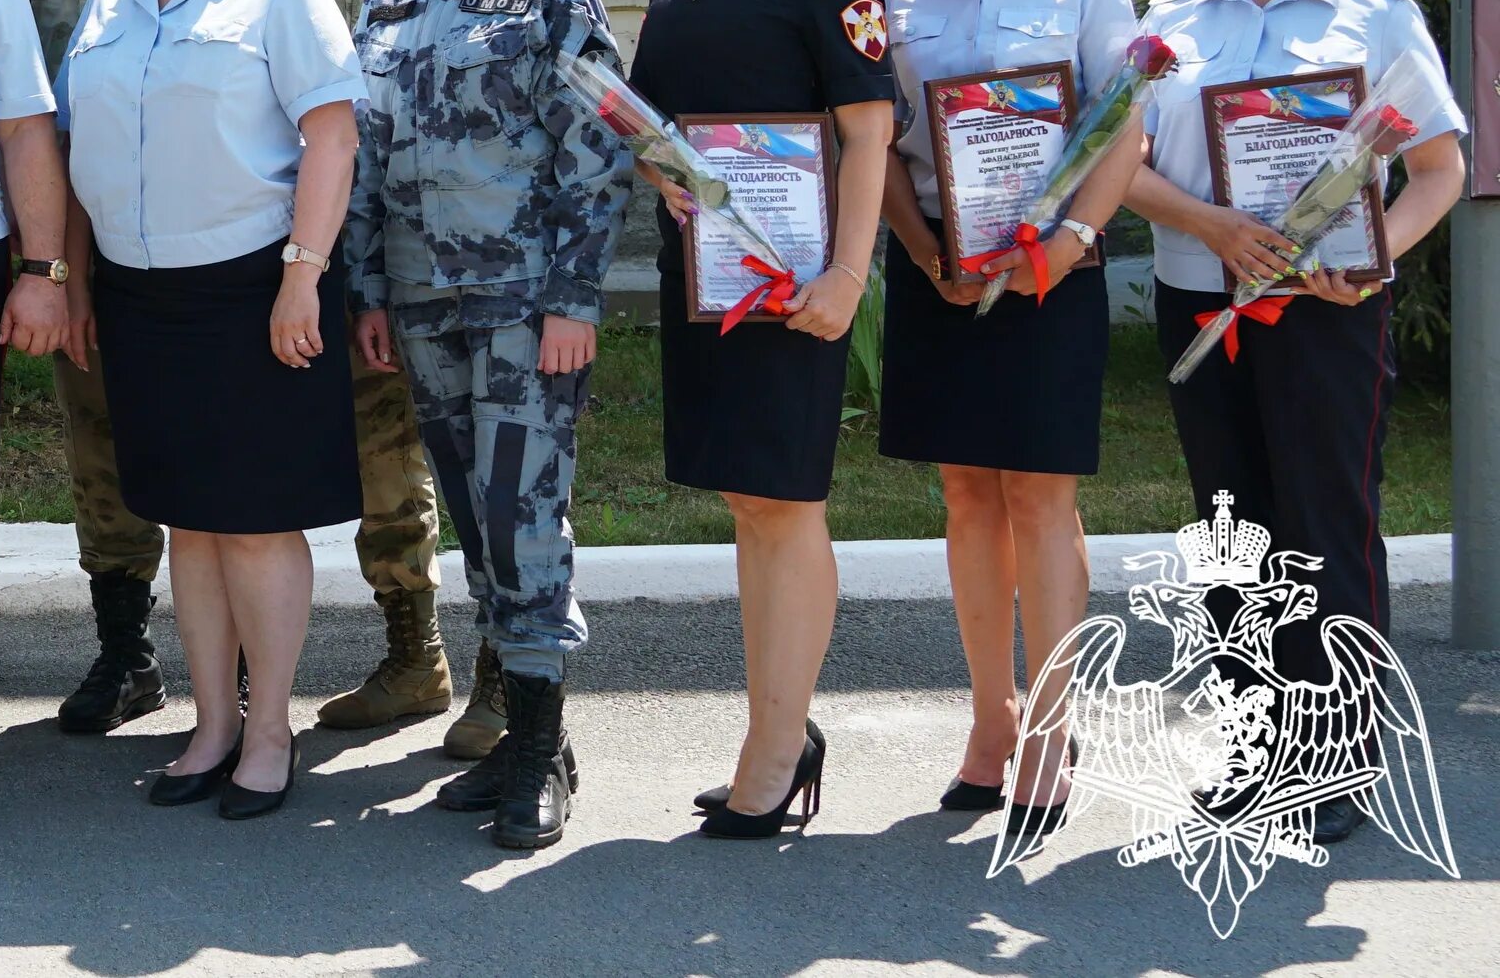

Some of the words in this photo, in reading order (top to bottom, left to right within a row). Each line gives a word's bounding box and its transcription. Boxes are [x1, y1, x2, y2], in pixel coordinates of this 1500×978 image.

[966, 125, 1049, 146] БЛАГОДАРНОСТЬ
[1244, 133, 1337, 153] БЛАГОДАРНОСТЬ
[720, 172, 802, 183] ЛАГОДАРНОСТЬ
